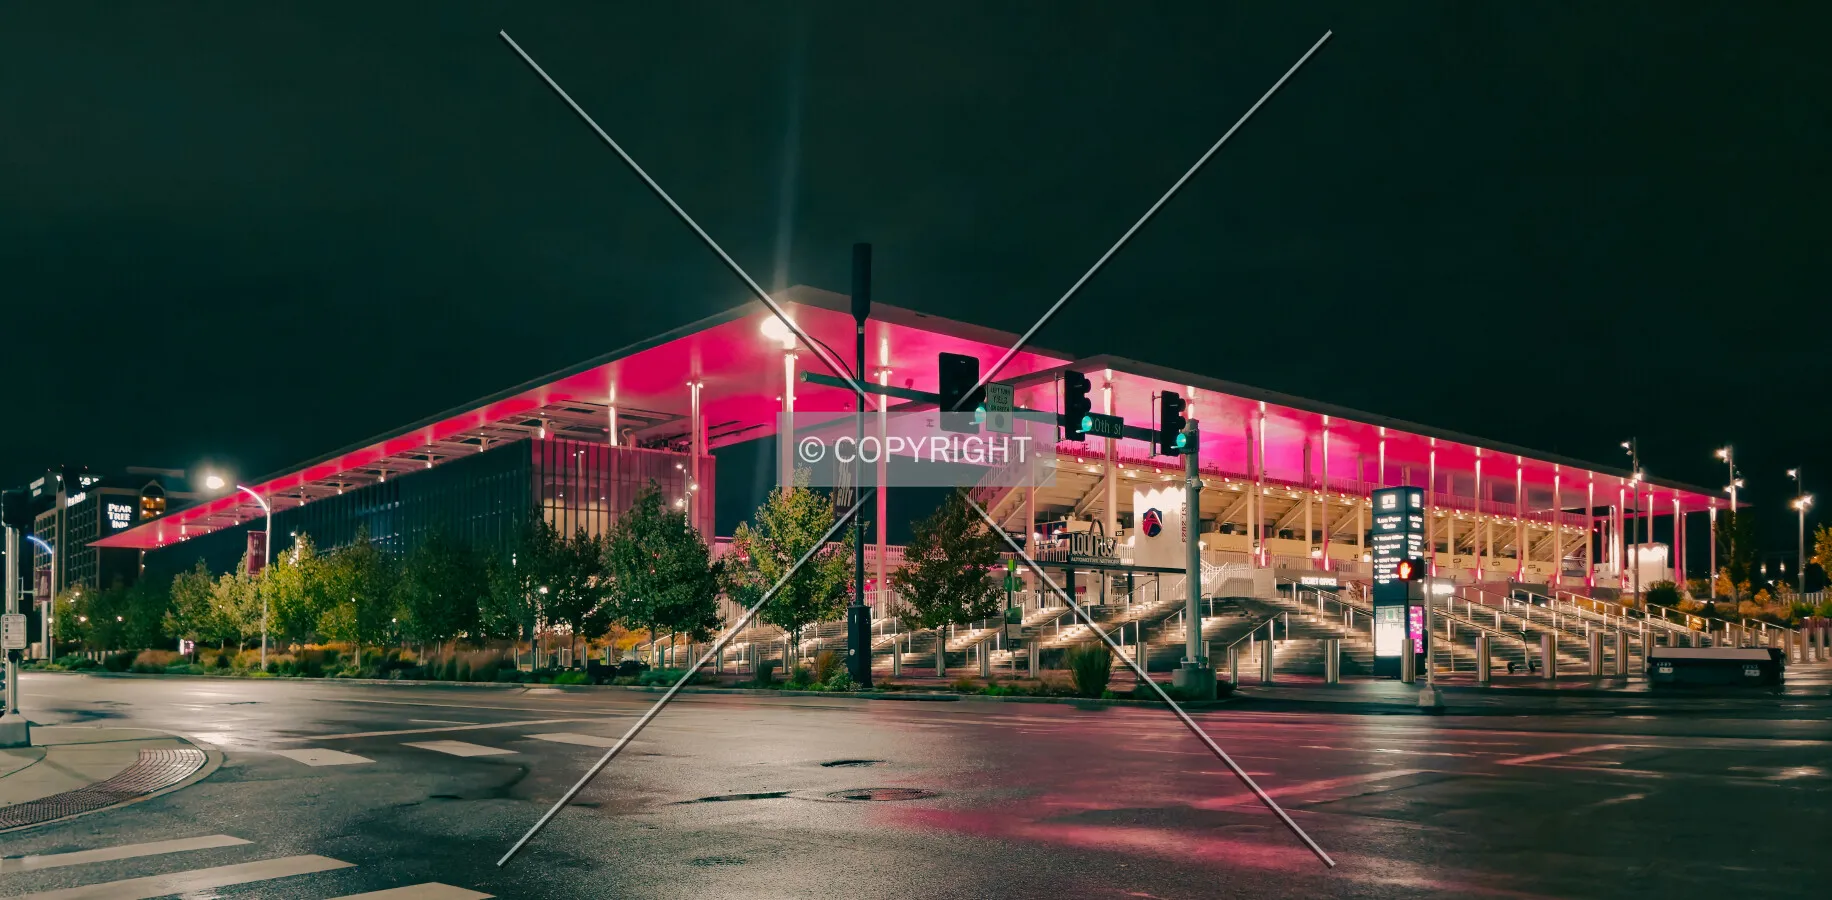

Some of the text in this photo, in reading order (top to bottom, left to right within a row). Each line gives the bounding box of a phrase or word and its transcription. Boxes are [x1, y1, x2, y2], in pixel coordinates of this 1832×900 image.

[1094, 417, 1110, 433] 0th
[108, 503, 132, 513] PEAR
[107, 511, 131, 521] TREE
[111, 519, 129, 529] INN
[1319, 577, 1337, 587] OFFICE
